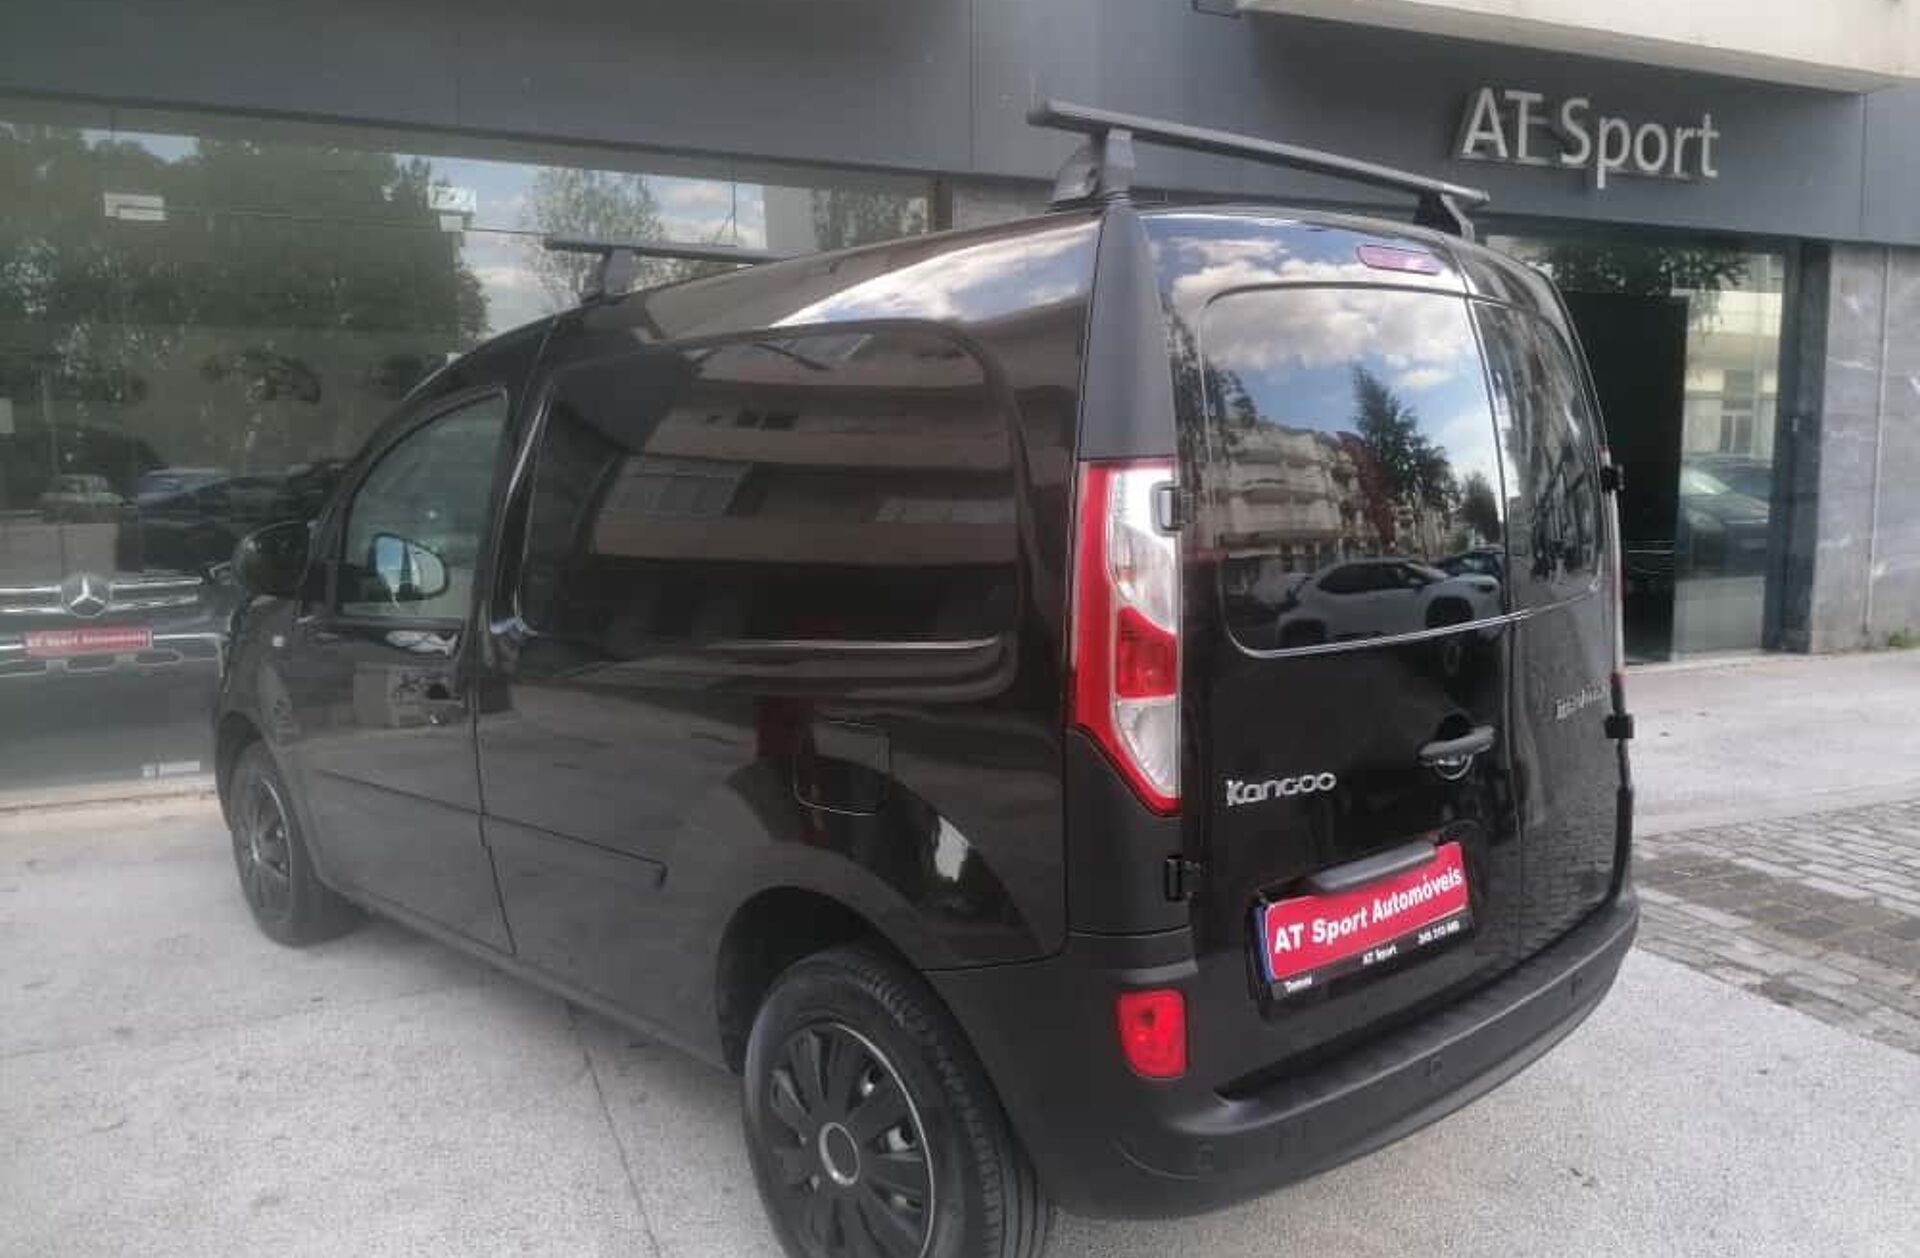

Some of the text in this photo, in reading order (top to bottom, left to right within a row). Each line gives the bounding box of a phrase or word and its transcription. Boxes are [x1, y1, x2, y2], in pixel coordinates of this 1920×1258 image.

[1461, 86, 1721, 190] AT Sport
[1226, 771, 1337, 806] Kangoo
[1273, 866, 1463, 955] AT Sport Automóveis
